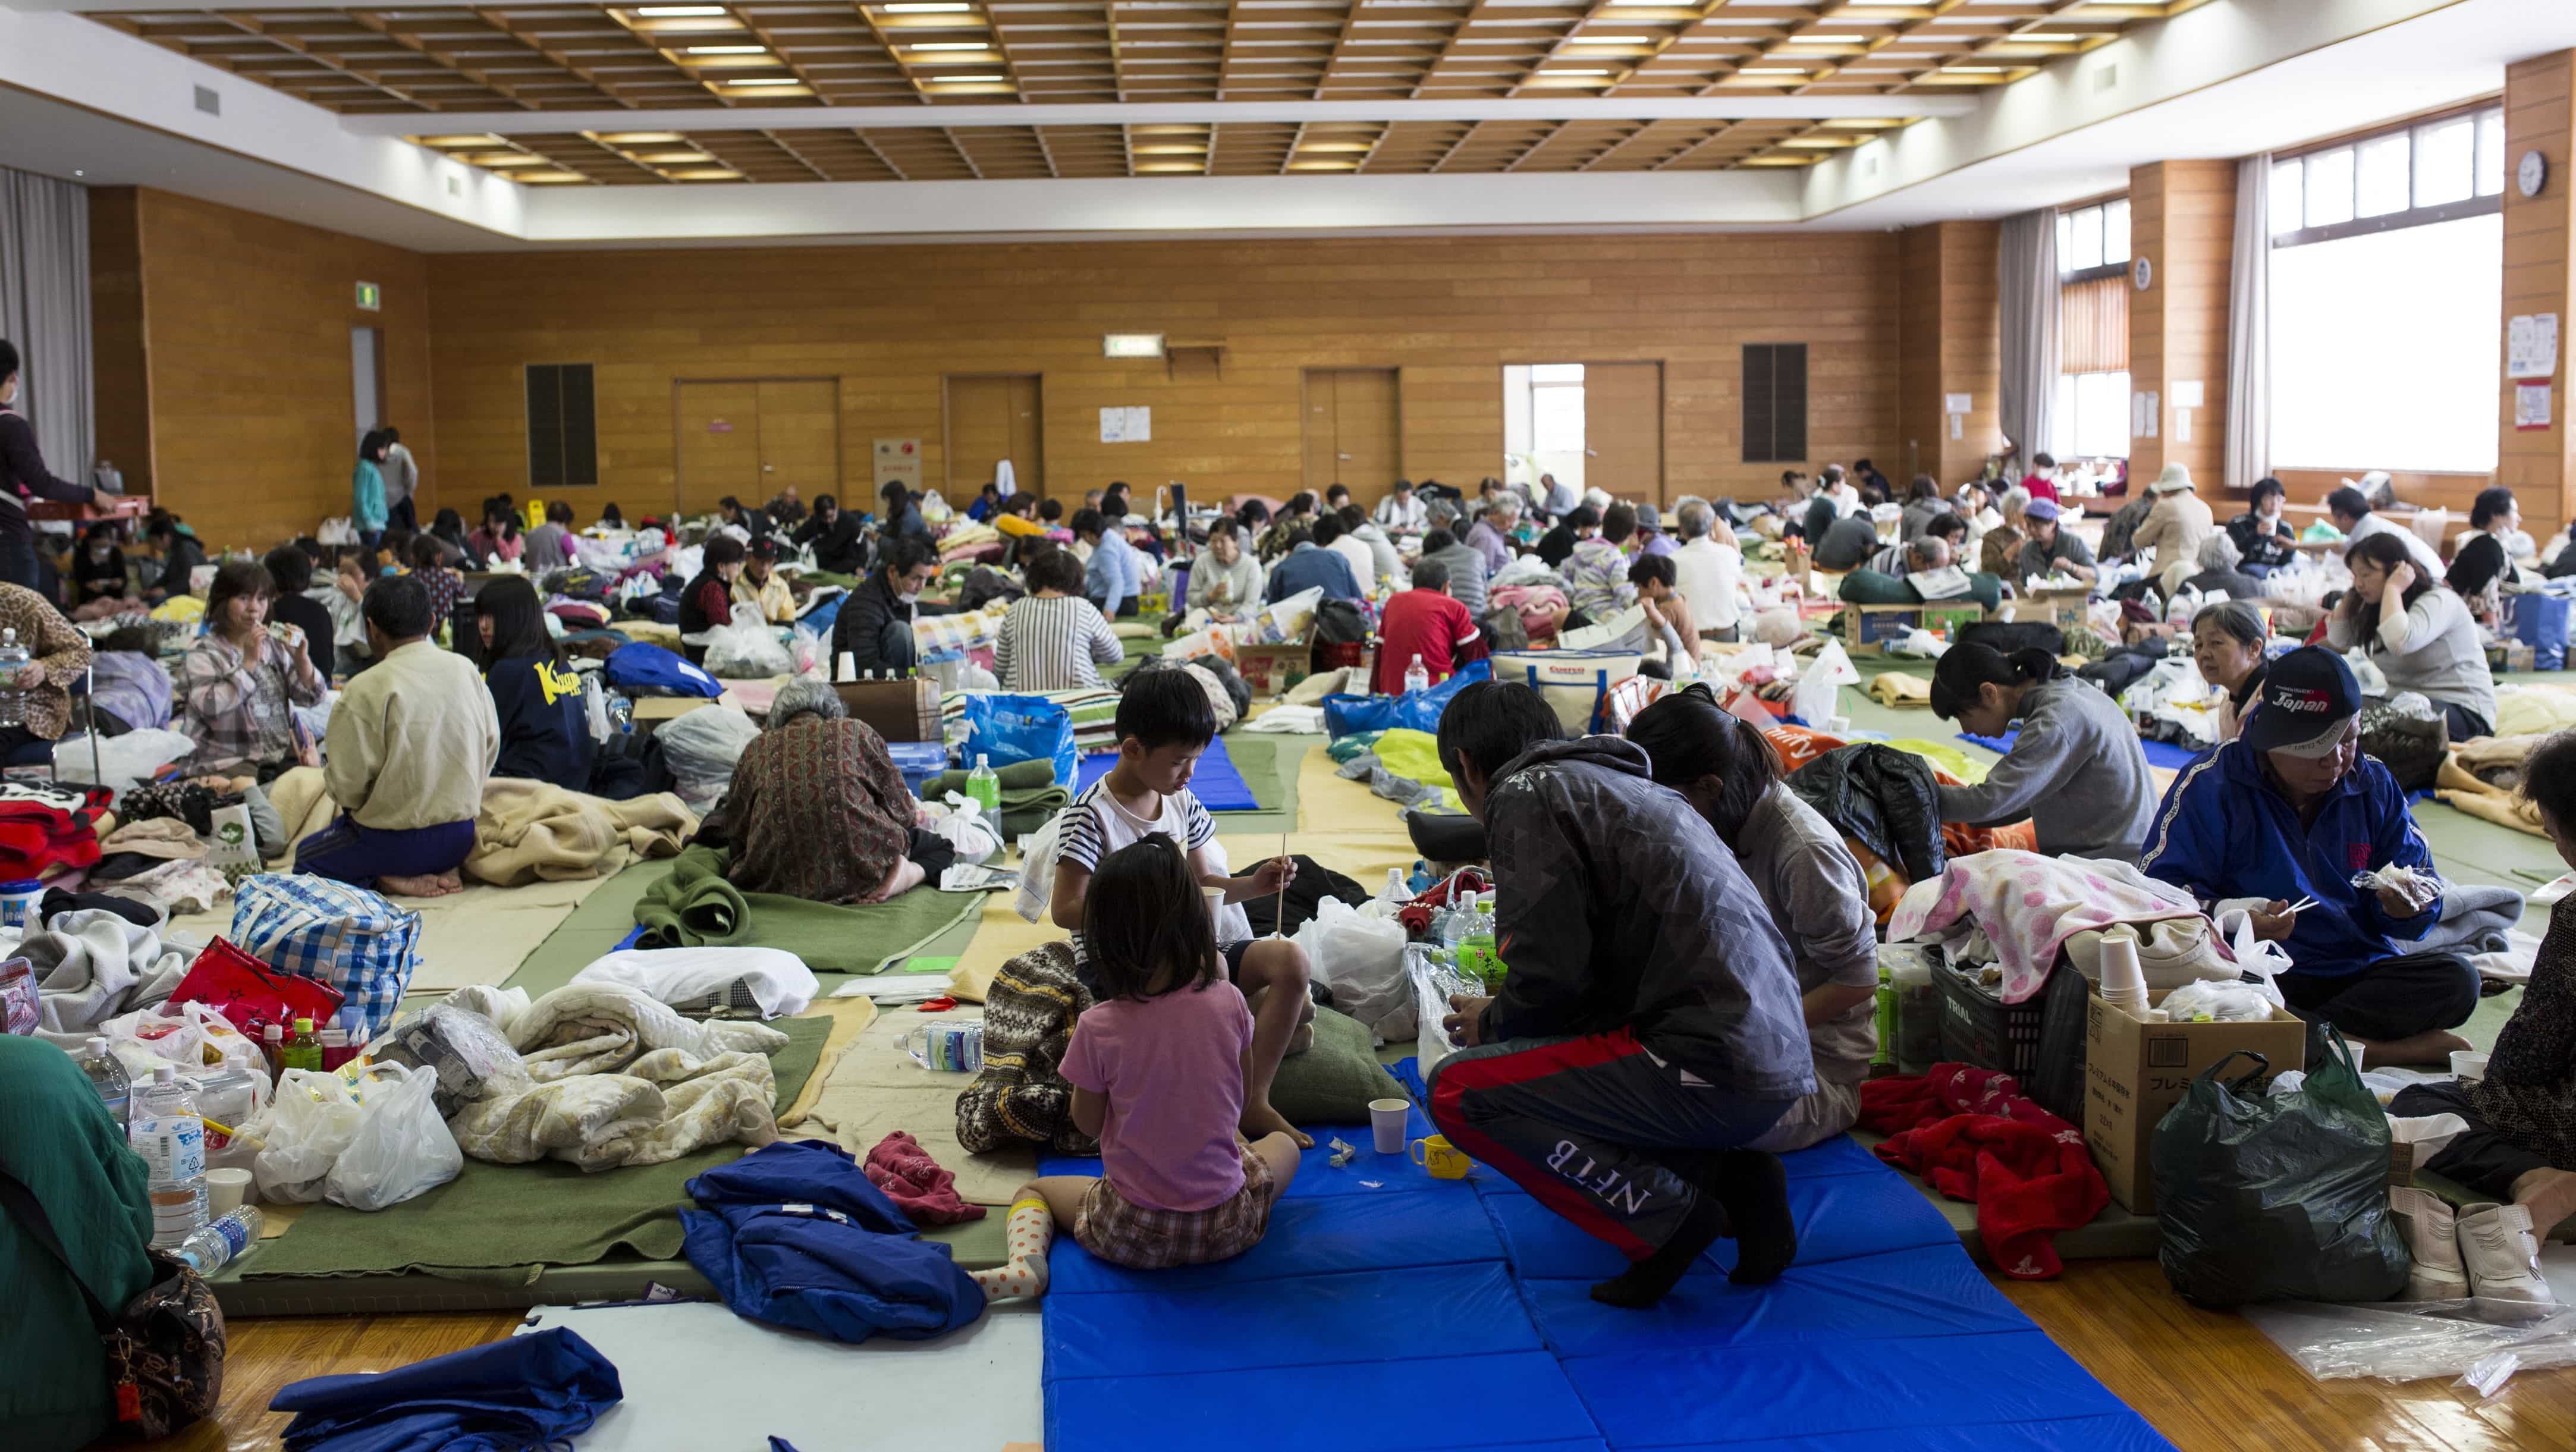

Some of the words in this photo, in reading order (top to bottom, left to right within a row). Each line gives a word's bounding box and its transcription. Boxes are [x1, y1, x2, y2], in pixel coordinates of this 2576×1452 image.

[2272, 692, 2328, 712] Japan
[1946, 995, 1972, 1026] TRIAL
[1546, 1140, 1652, 1215] NFTB
